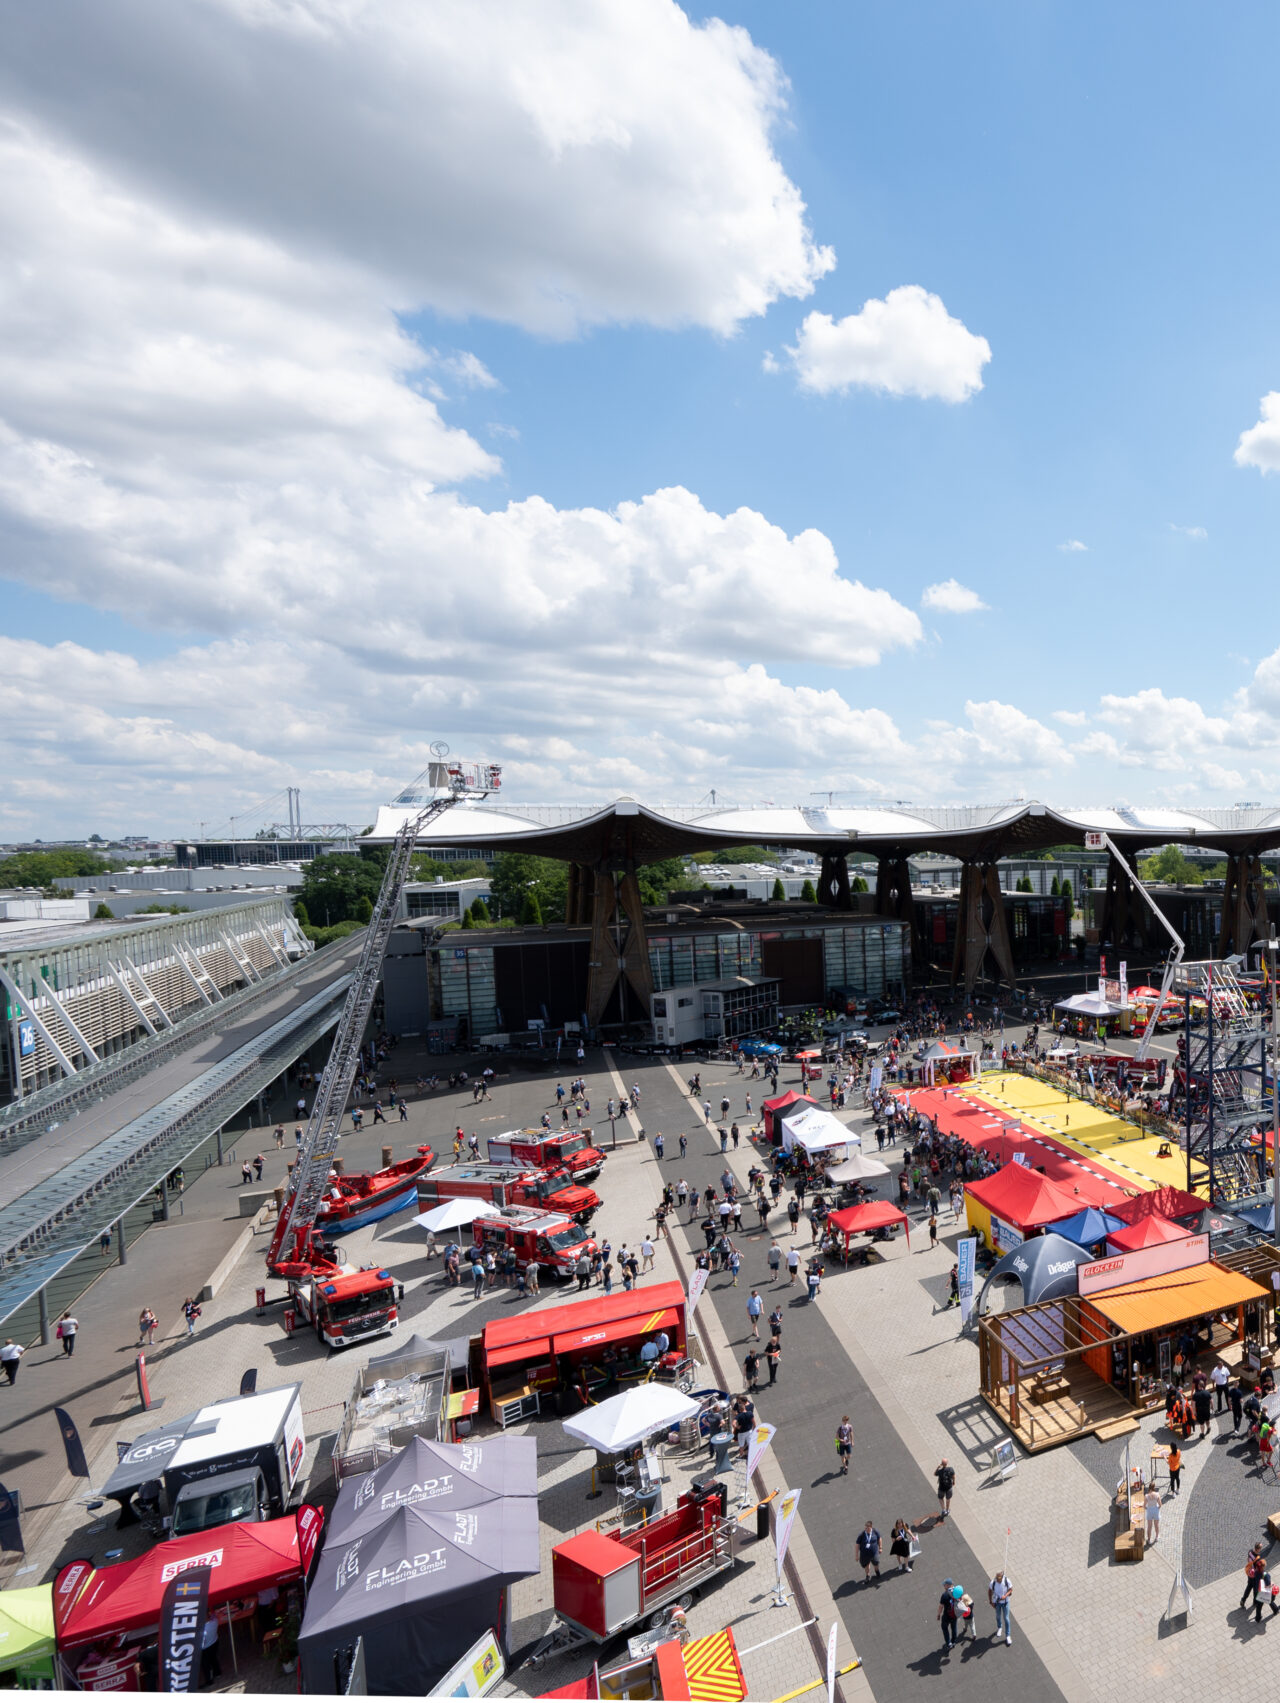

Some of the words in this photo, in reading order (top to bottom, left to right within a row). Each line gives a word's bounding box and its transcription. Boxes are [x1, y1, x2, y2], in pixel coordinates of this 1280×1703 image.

[22, 1026, 33, 1047] 26
[1186, 1239, 1204, 1248] STIHL
[960, 1242, 969, 1283] BAUER
[1048, 1260, 1076, 1275] Dräger
[1085, 1260, 1123, 1275] GLOCKZIN
[692, 1270, 704, 1295] FLADT
[343, 1459, 364, 1467] FLADT
[460, 1445, 473, 1471] FLADT
[381, 1475, 452, 1504] FLADT
[381, 1492, 427, 1510] Engineering
[430, 1484, 453, 1496] GmbH
[302, 1510, 314, 1528] SERRA
[454, 1513, 467, 1543] FLADT
[165, 1554, 219, 1578] SERRA
[366, 1548, 446, 1584] FLADT
[366, 1569, 417, 1591] Engineering
[420, 1559, 446, 1571] GmbH
[63, 1567, 81, 1591] SERRA
[94, 1674, 127, 1690] SERRA
